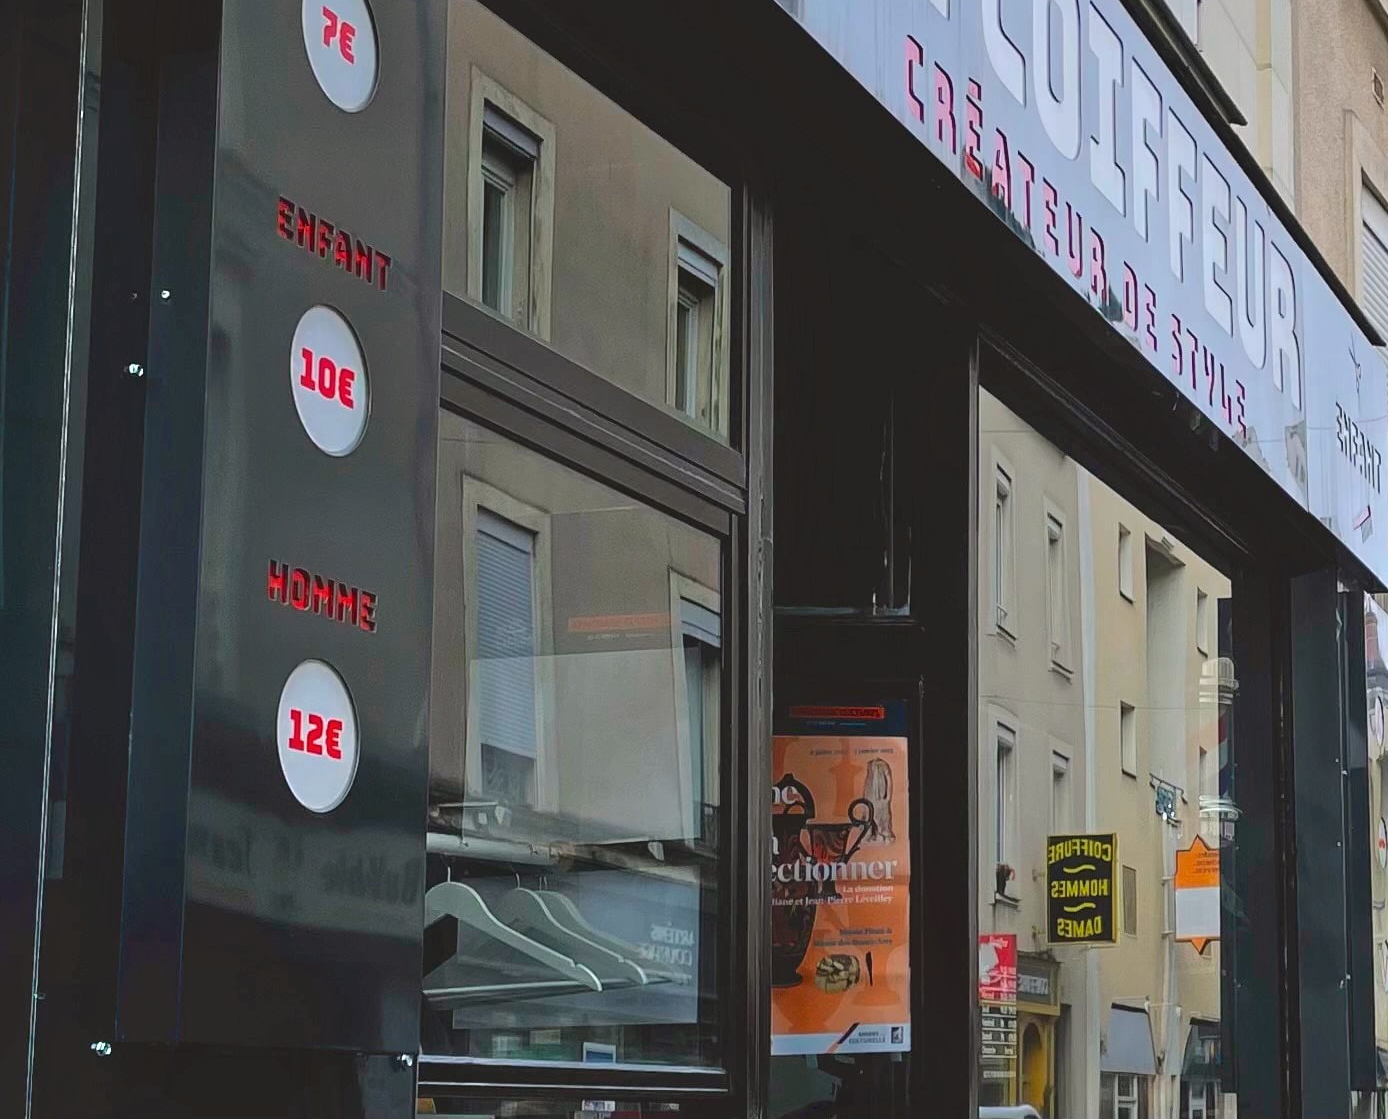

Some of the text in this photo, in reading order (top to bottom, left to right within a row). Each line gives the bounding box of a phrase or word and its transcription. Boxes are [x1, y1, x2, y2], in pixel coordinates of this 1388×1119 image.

[321, 6, 357, 65] 7€
[276, 195, 392, 292] ENFANT
[904, 36, 1247, 439] CRÉATEUR DE STYLE
[299, 347, 355, 410] 10€
[1336, 401, 1382, 495] ENFANT
[266, 558, 378, 633] HOMME
[287, 709, 343, 760] 12€
[794, 898, 803, 906] et
